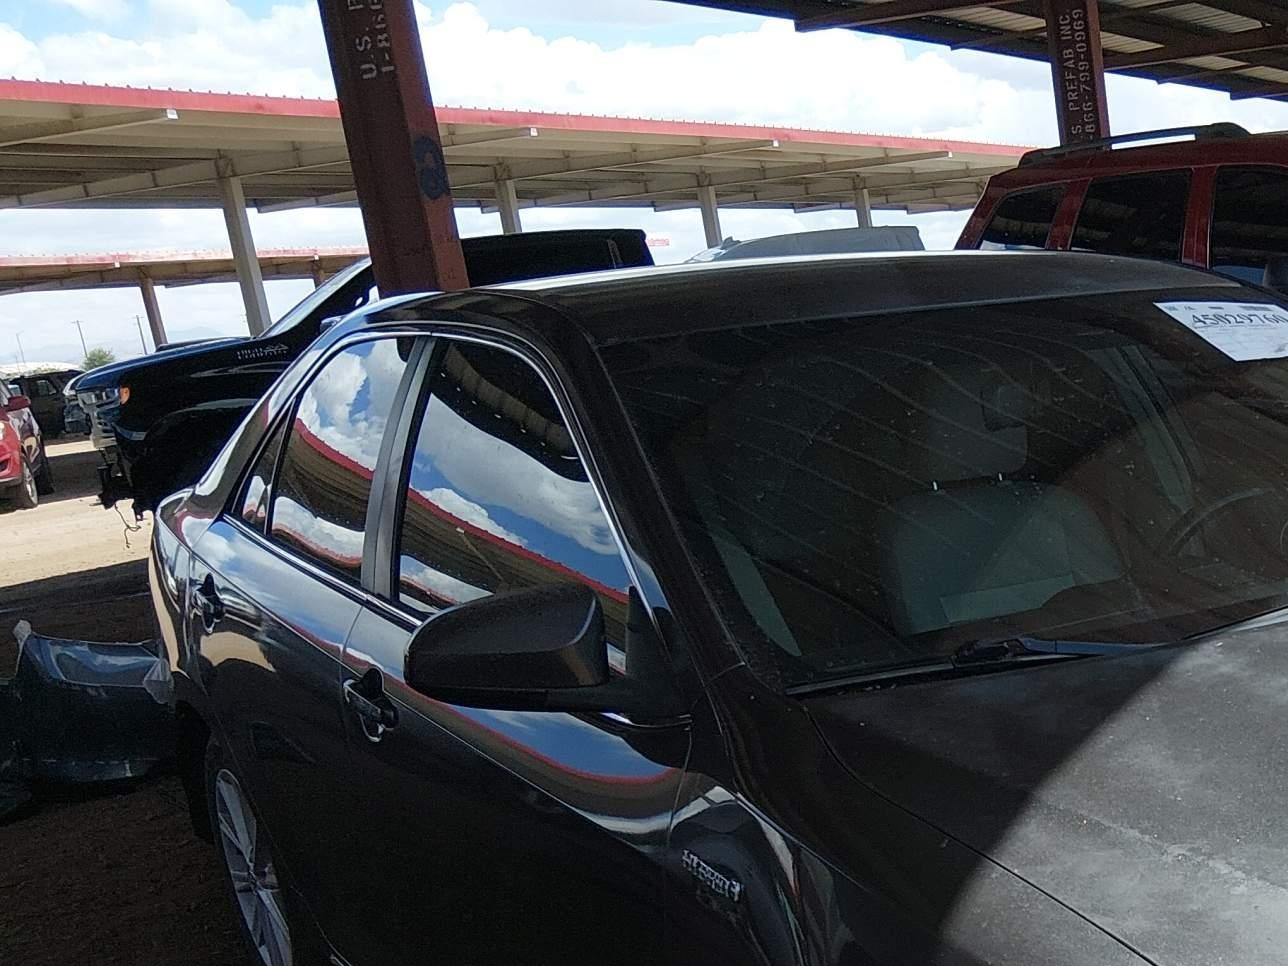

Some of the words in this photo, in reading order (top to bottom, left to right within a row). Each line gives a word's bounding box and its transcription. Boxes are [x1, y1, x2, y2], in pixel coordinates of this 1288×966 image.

[355, 26, 377, 80] U.S.
[1059, 8, 1073, 40] INC.
[1062, 48, 1081, 111] PREFAB
[1072, 9, 1096, 141] -866-799-0969
